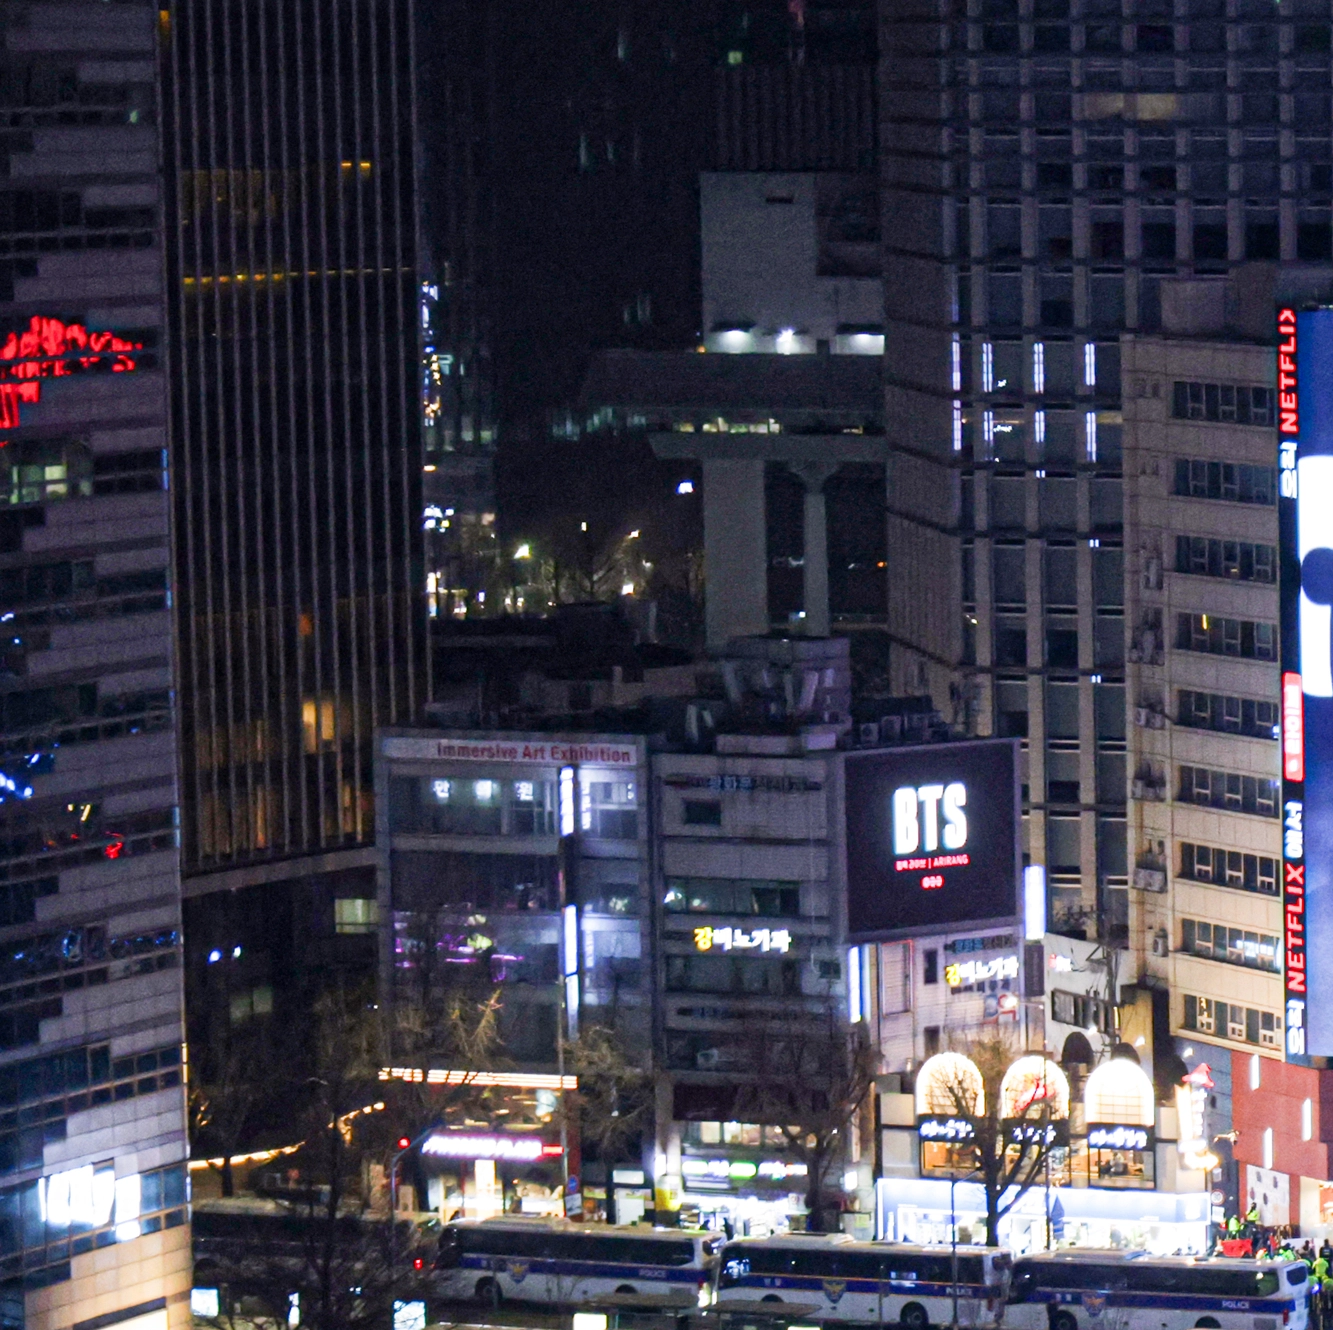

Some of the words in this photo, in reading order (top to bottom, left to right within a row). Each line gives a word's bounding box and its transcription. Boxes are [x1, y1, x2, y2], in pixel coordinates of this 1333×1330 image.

[437, 742, 518, 760] Immersive
[522, 745, 546, 761] Art
[550, 744, 631, 763] Exhibition
[893, 781, 968, 855] BTS
[1284, 800, 1303, 858] 에서
[933, 854, 969, 867] ARIRANG
[1285, 862, 1306, 993] NETFLIX
[1221, 1300, 1250, 1310] POLICE
